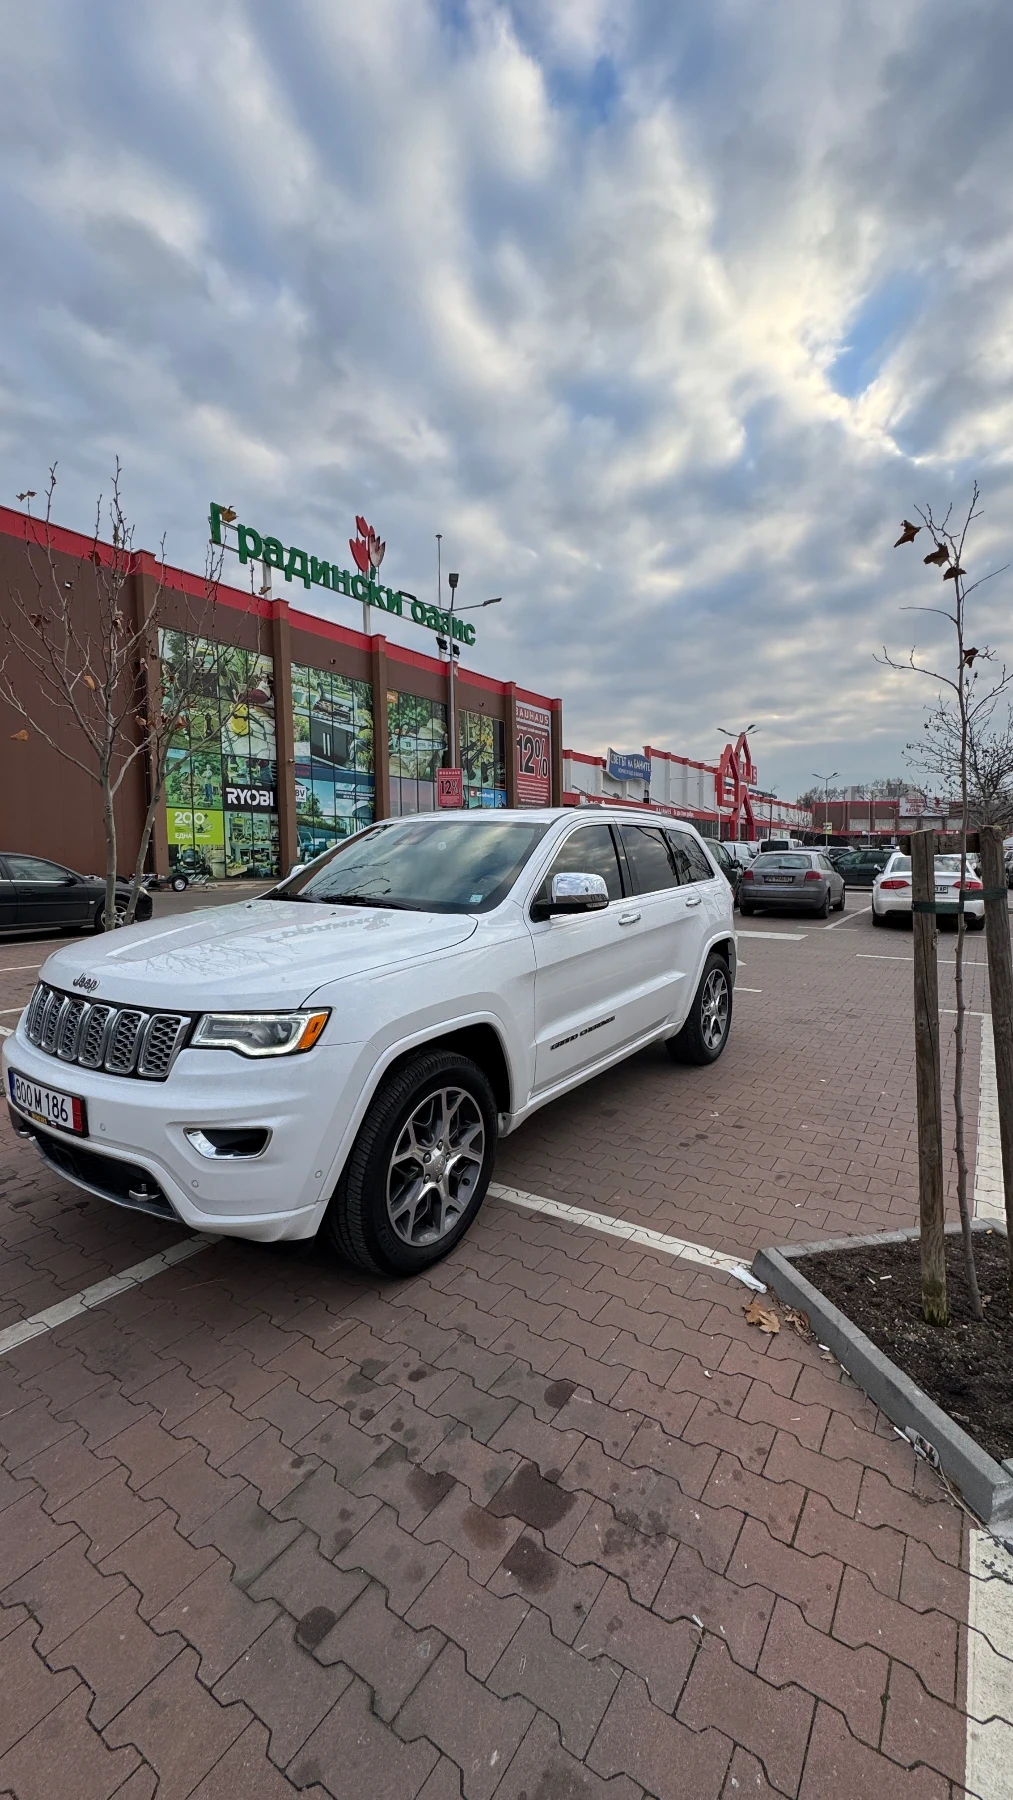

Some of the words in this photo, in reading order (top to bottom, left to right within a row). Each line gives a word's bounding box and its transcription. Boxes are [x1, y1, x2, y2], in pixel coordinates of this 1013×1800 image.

[210, 502, 403, 616] Градински
[411, 600, 476, 646] оазис
[517, 733, 548, 778] 12%
[226, 787, 274, 807] RYOBI
[440, 780, 460, 795] 12%
[175, 832, 193, 840] ЕДНА
[73, 973, 100, 993] Jeep
[15, 1078, 33, 1107] 800
[34, 1088, 42, 1112] M
[45, 1093, 68, 1122] 186
